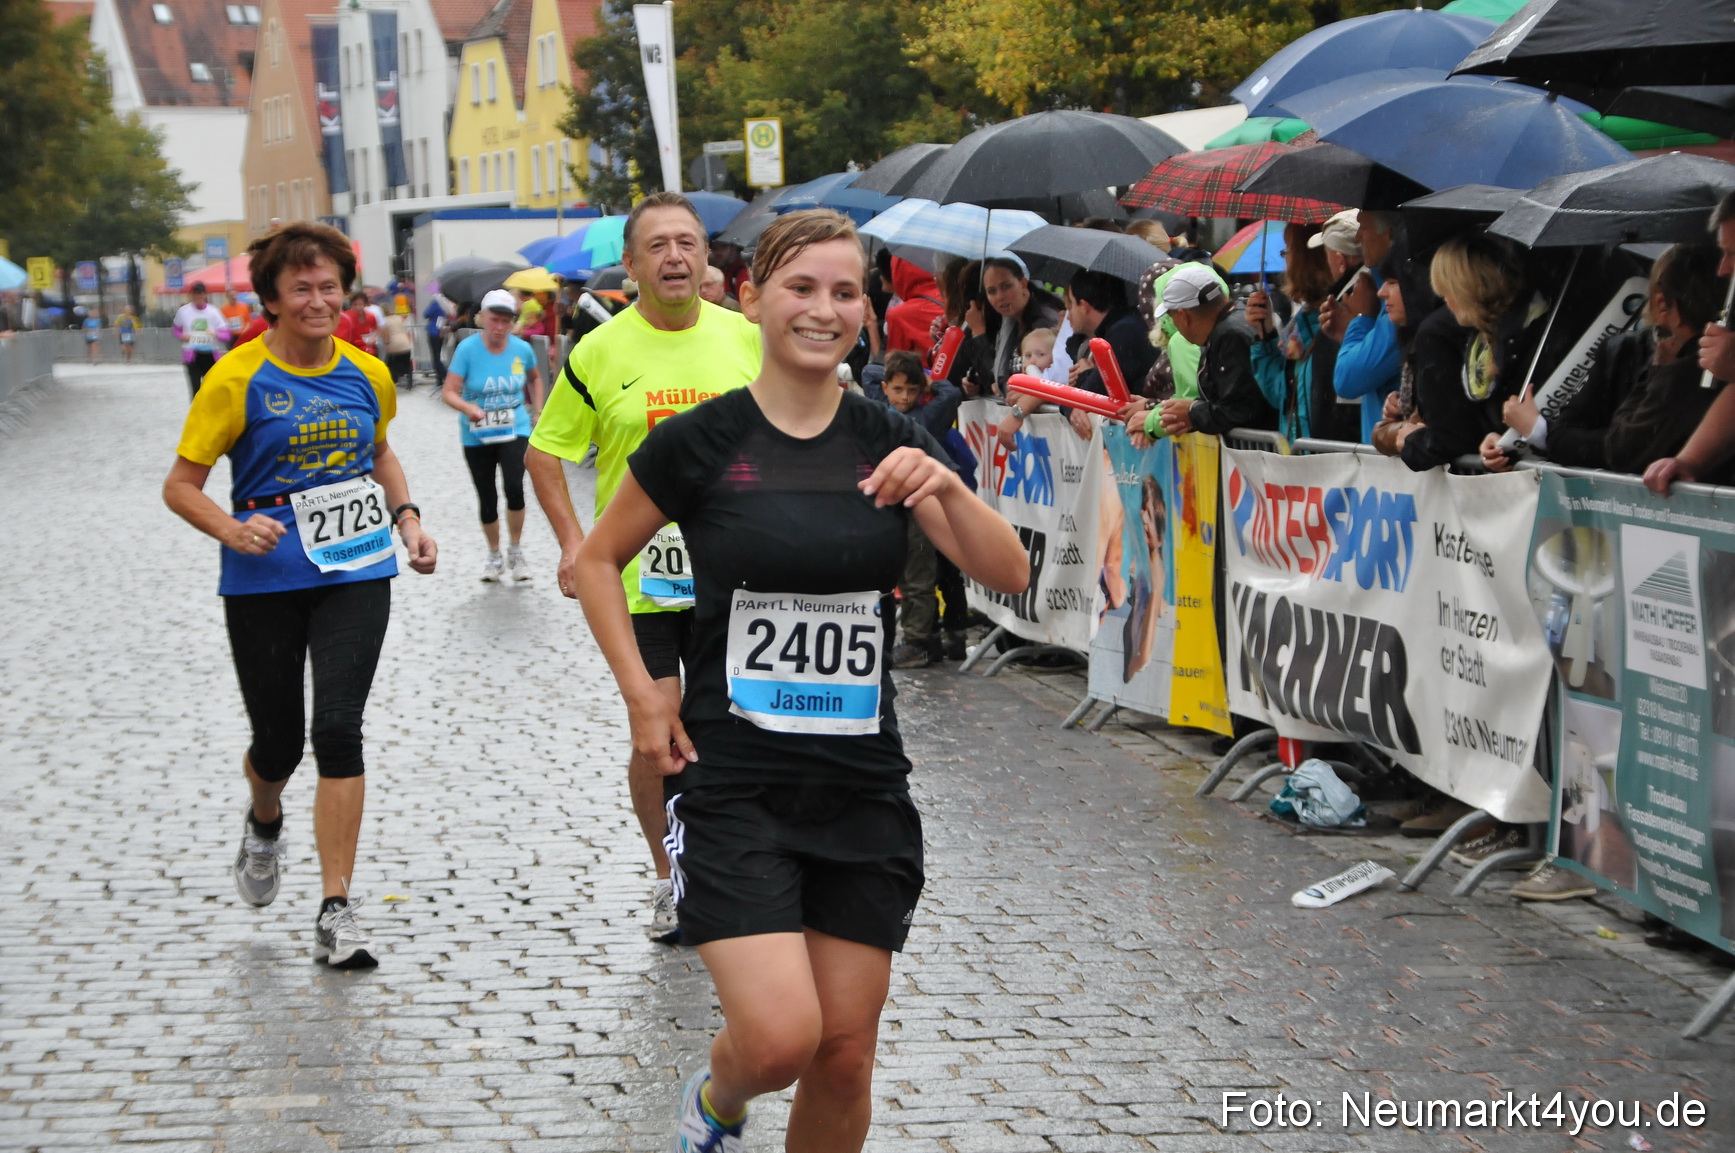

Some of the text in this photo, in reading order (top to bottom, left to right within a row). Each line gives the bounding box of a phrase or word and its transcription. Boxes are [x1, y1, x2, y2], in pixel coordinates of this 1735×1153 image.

[295, 495, 329, 511] PARTL
[308, 493, 383, 544] 2723
[322, 536, 385, 564] Rosemarie
[735, 599, 867, 615] PARTL Neumarkt
[745, 618, 877, 677] 2405
[1458, 644, 1487, 688] Stadt
[769, 688, 843, 713] Jasmin
